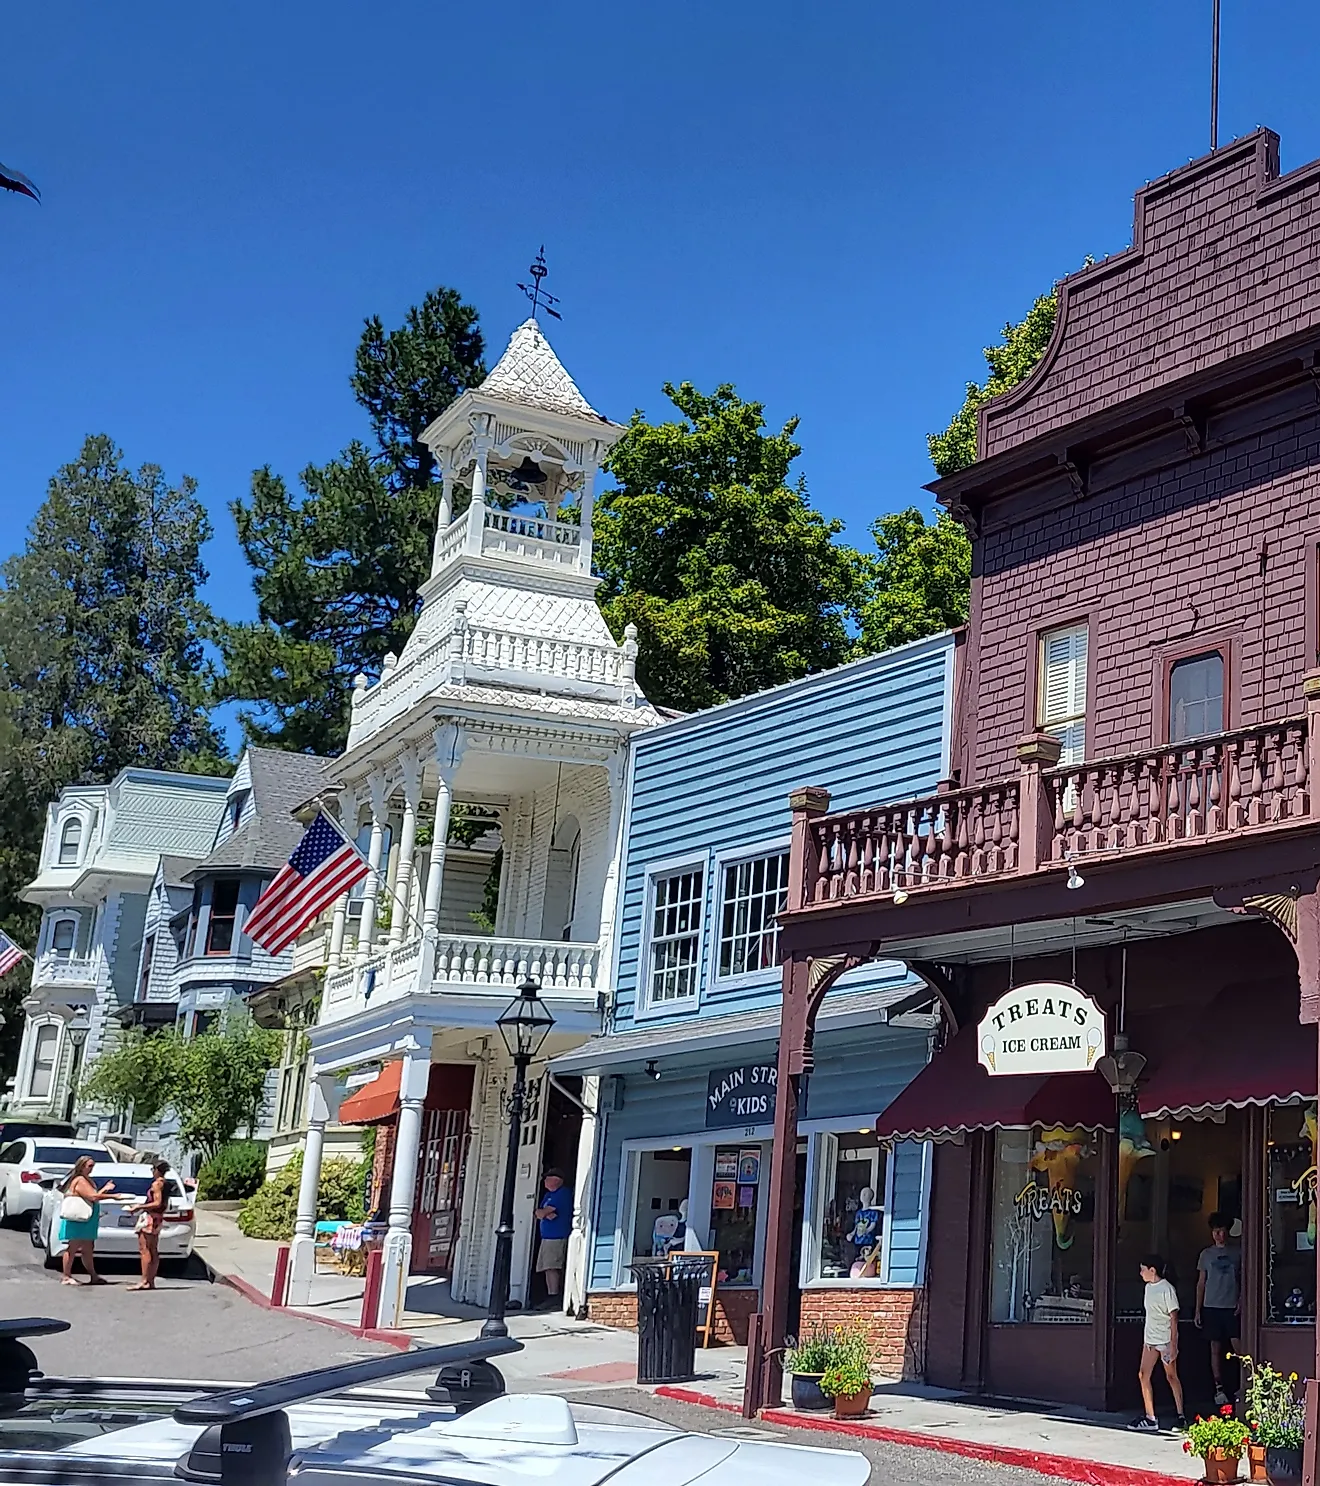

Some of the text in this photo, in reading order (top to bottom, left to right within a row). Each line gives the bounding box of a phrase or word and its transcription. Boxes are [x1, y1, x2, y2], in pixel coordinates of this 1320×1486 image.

[991, 999, 1088, 1032] TREATS
[1002, 1036, 1082, 1054] ICE CREAM
[708, 1068, 745, 1110] MAIN
[736, 1095, 767, 1116] KIDS
[744, 1127, 755, 1137] 212
[1015, 1181, 1082, 1219] TREATS
